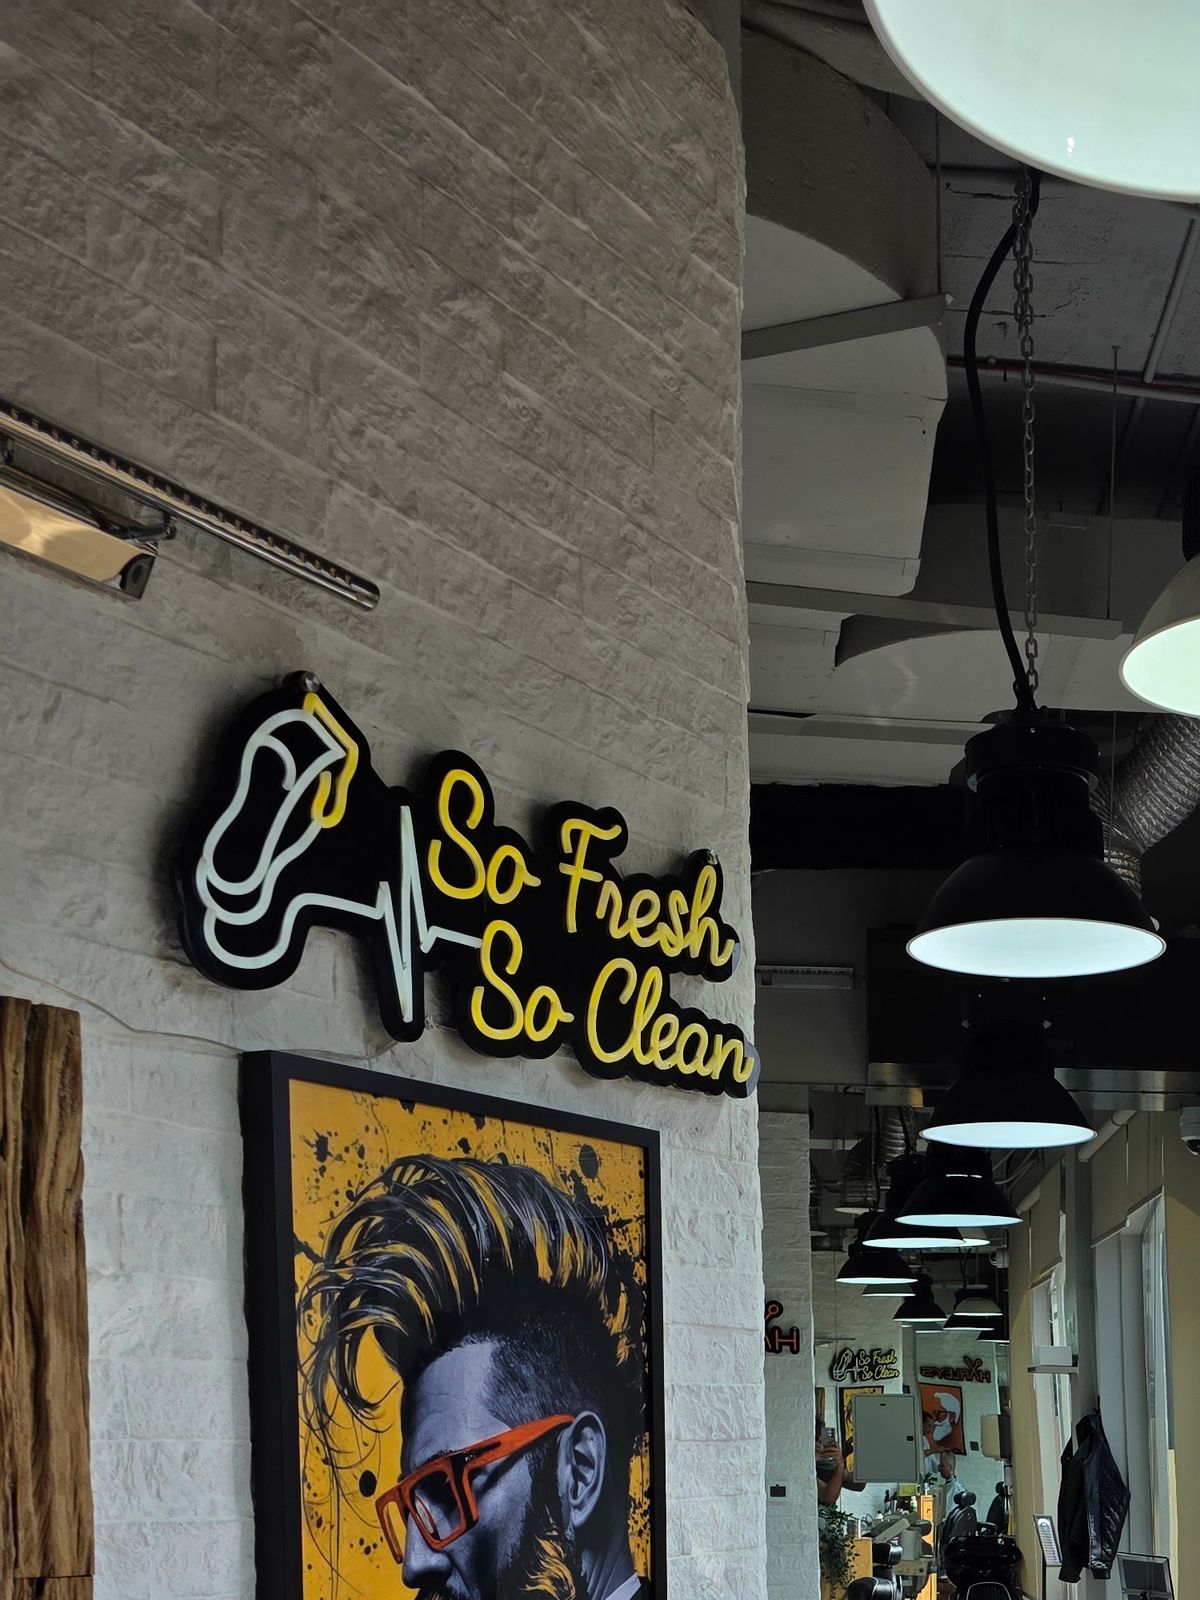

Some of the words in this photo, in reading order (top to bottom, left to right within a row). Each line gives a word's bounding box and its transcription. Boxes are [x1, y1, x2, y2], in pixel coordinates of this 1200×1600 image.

[427, 768, 542, 905] So
[559, 817, 736, 968] Fresh
[471, 919, 574, 1042] So
[587, 957, 755, 1084] Clean
[858, 1350, 871, 1365] So
[872, 1348, 897, 1364] Fresh
[862, 1364, 875, 1380] So
[875, 1363, 901, 1379] Clean
